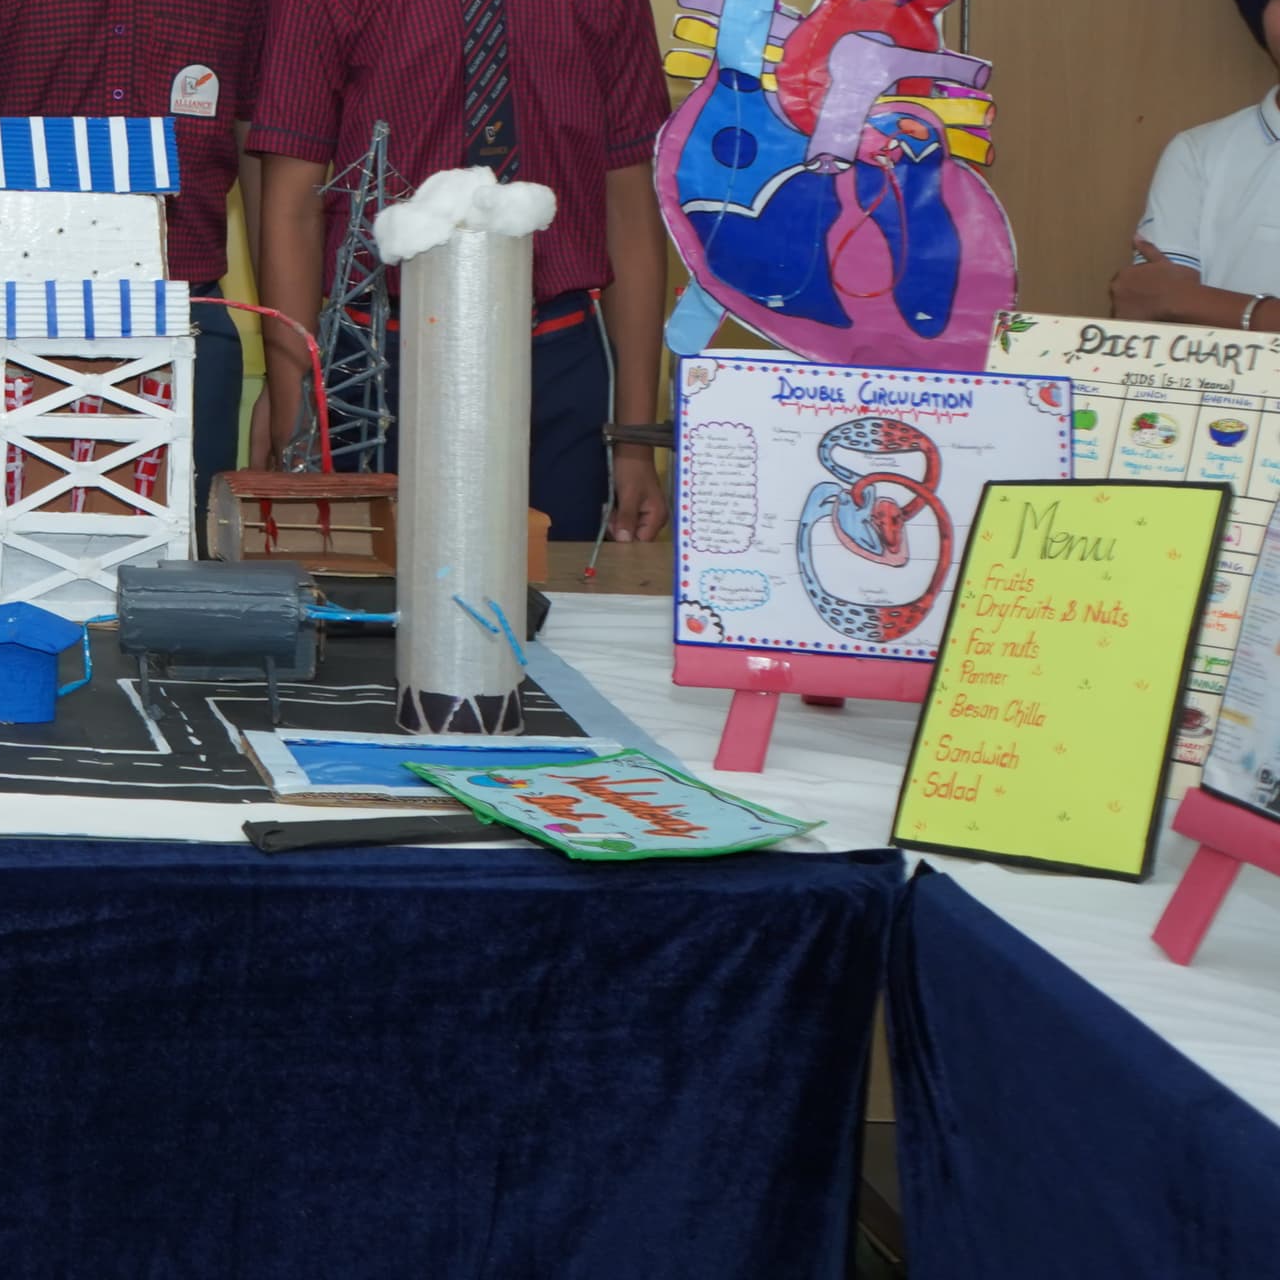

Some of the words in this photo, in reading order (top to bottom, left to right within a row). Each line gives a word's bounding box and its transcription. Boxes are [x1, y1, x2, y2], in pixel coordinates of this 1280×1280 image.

[175, 99, 213, 108] ALLIANCE
[1075, 324, 1160, 360] DIET
[1169, 334, 1264, 375] CHART
[771, 375, 846, 404] DOUBLE
[858, 380, 973, 409] CIRCULATION
[1011, 501, 1117, 562] Menu
[1083, 600, 1130, 628] Nuts
[1002, 631, 1041, 659] nuts
[950, 693, 999, 720] Besan
[1003, 699, 1047, 728] Chilla
[935, 734, 1020, 769] Sandwich
[923, 771, 983, 802] Salad
